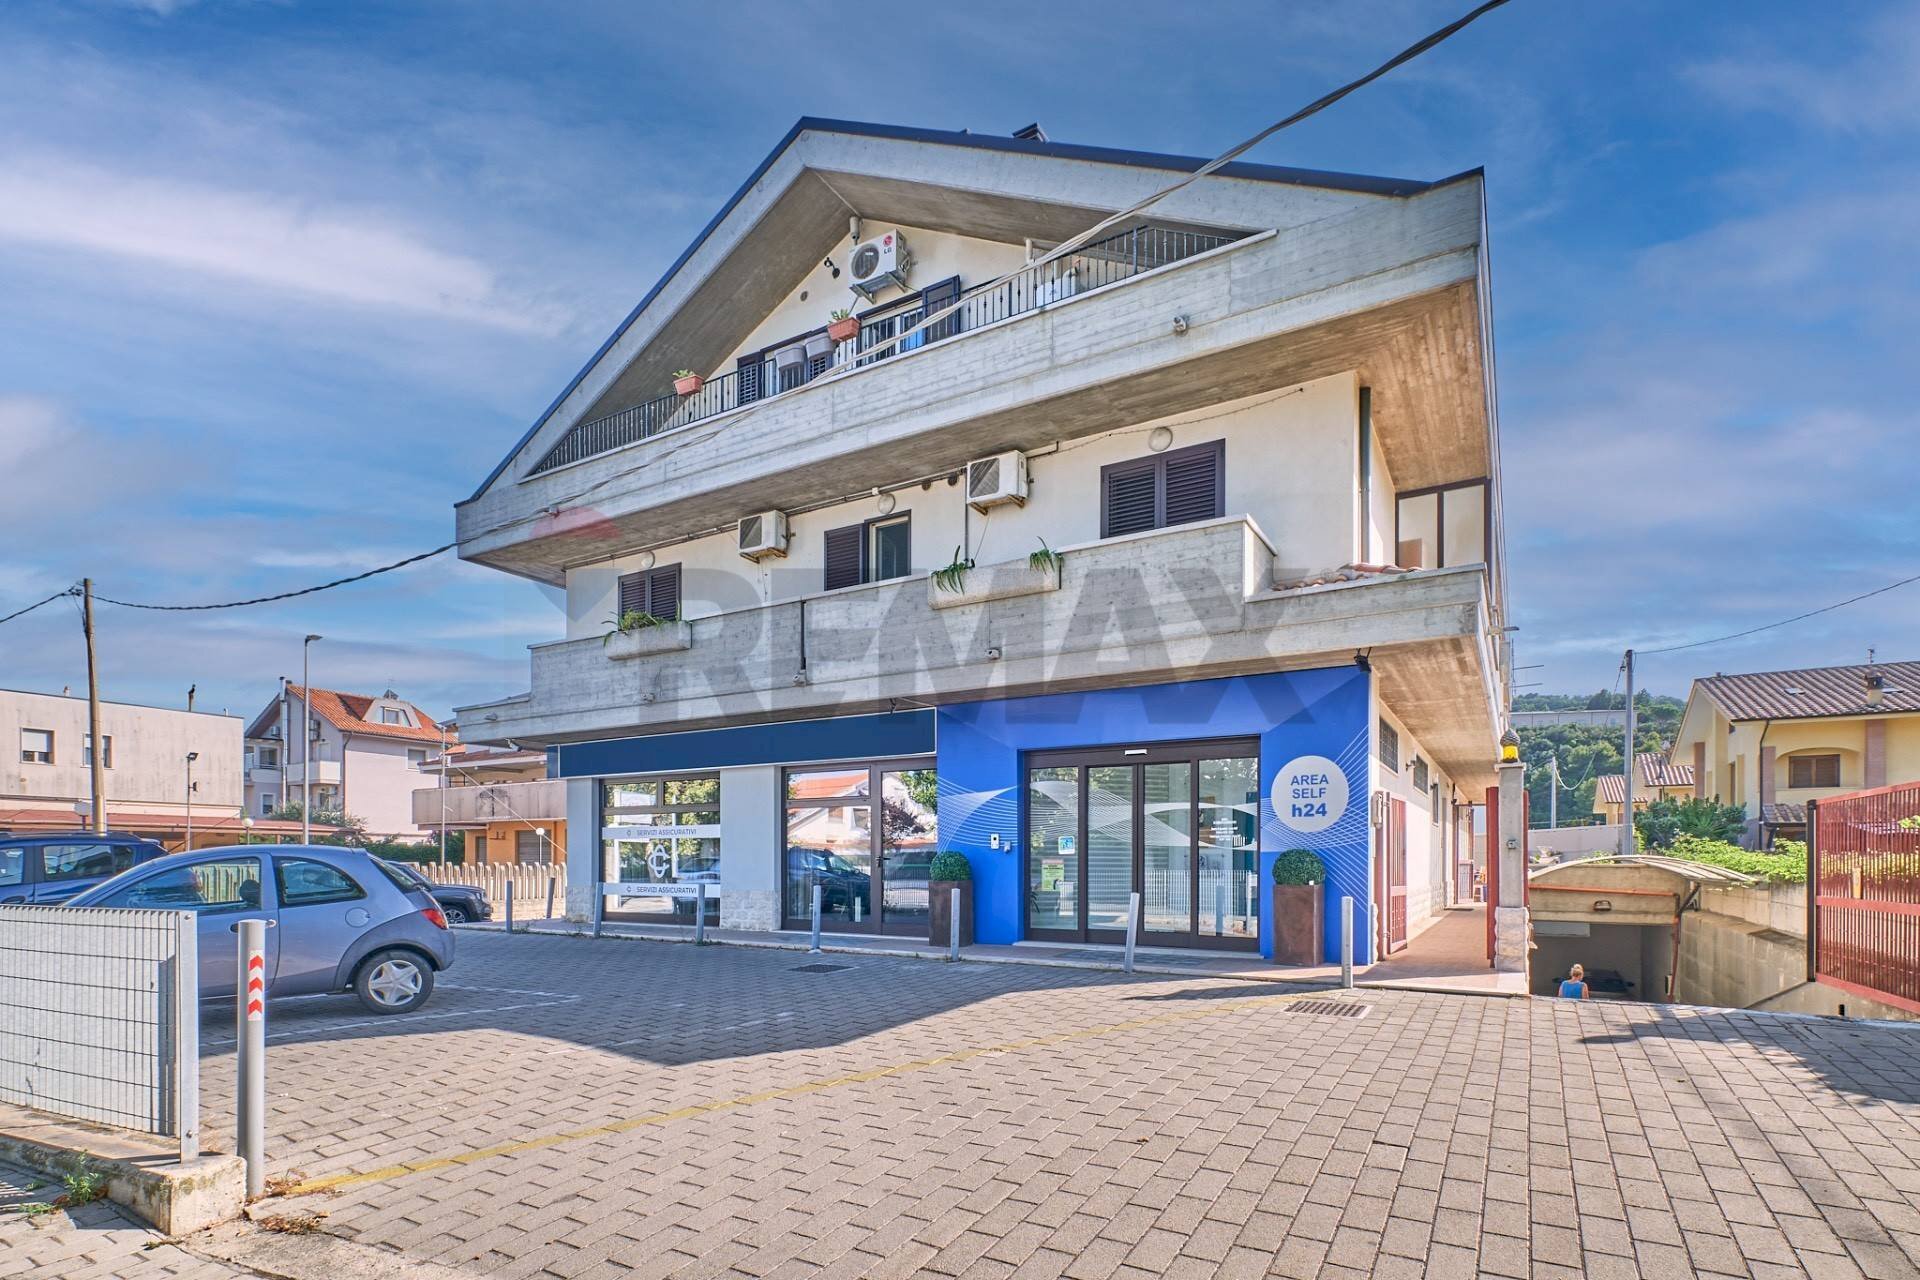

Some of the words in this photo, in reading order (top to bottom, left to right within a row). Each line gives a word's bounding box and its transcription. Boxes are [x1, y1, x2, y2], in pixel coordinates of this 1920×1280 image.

[1290, 774, 1329, 786] AREA
[1292, 787, 1327, 799] SELF
[1291, 803, 1328, 818] h24
[658, 828, 697, 836] ASSICURATIVI
[658, 886, 697, 894] ASSICURATIVI
